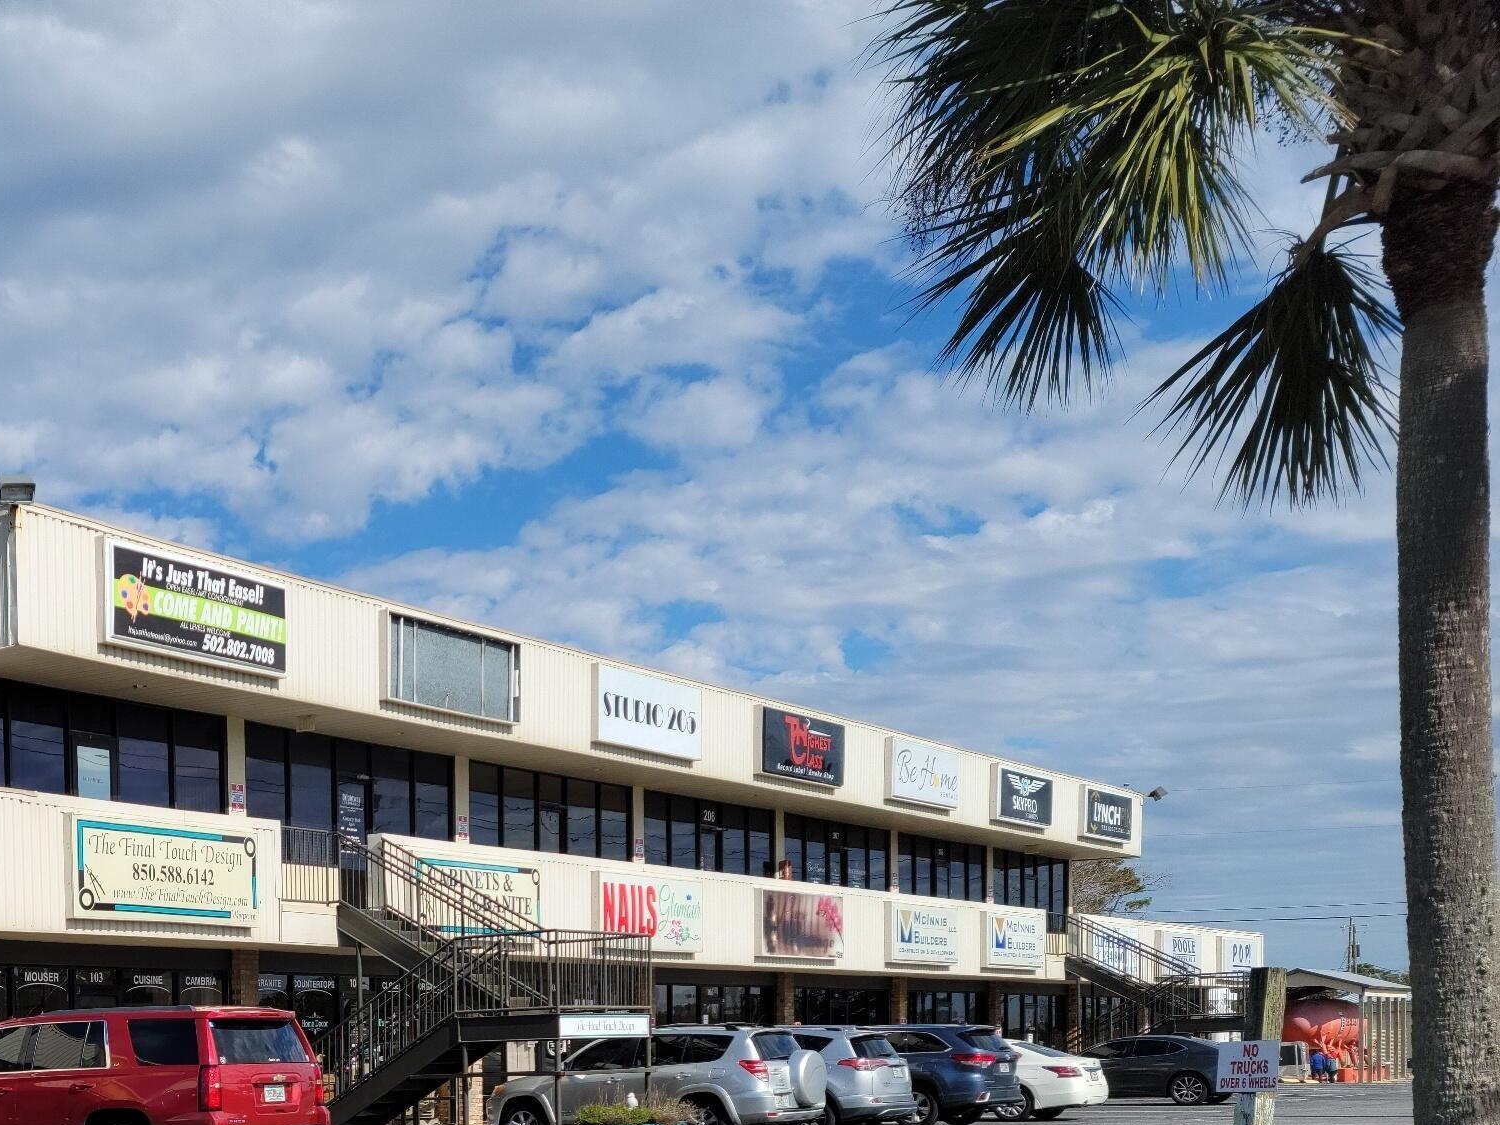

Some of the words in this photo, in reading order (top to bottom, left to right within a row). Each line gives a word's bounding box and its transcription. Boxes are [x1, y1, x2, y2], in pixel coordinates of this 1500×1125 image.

[142, 557, 163, 582] It's
[165, 564, 194, 587] Just
[197, 570, 226, 594] That
[228, 578, 264, 605] Easel!
[154, 591, 197, 623] COME
[201, 602, 233, 630] AND
[236, 610, 283, 640] PAINT!
[202, 634, 275, 664] 502.802.7008
[603, 691, 664, 728] STUDIO
[668, 707, 697, 734] 205
[897, 748, 917, 784] Be
[89, 832, 115, 855] The
[118, 837, 156, 860] Final
[159, 840, 197, 862] Touch
[201, 845, 243, 872] Design
[132, 863, 215, 886] 850.588.6142
[503, 874, 514, 892] &
[603, 882, 658, 937] NAILS
[914, 931, 948, 946] BUILDERS
[1007, 937, 1036, 951] BUILDERS
[1172, 939, 1196, 953] POOLE
[24, 971, 59, 983] MOUSER
[89, 972, 104, 983] 103
[133, 975, 163, 985] CUISINE
[185, 976, 217, 986] CAMBRIA
[1243, 1044, 1259, 1057] NO
[1231, 1060, 1269, 1074] TRUCKS
[1220, 1078, 1240, 1089] OVER
[1242, 1078, 1247, 1088] 6
[1248, 1077, 1277, 1089] WHEELS
